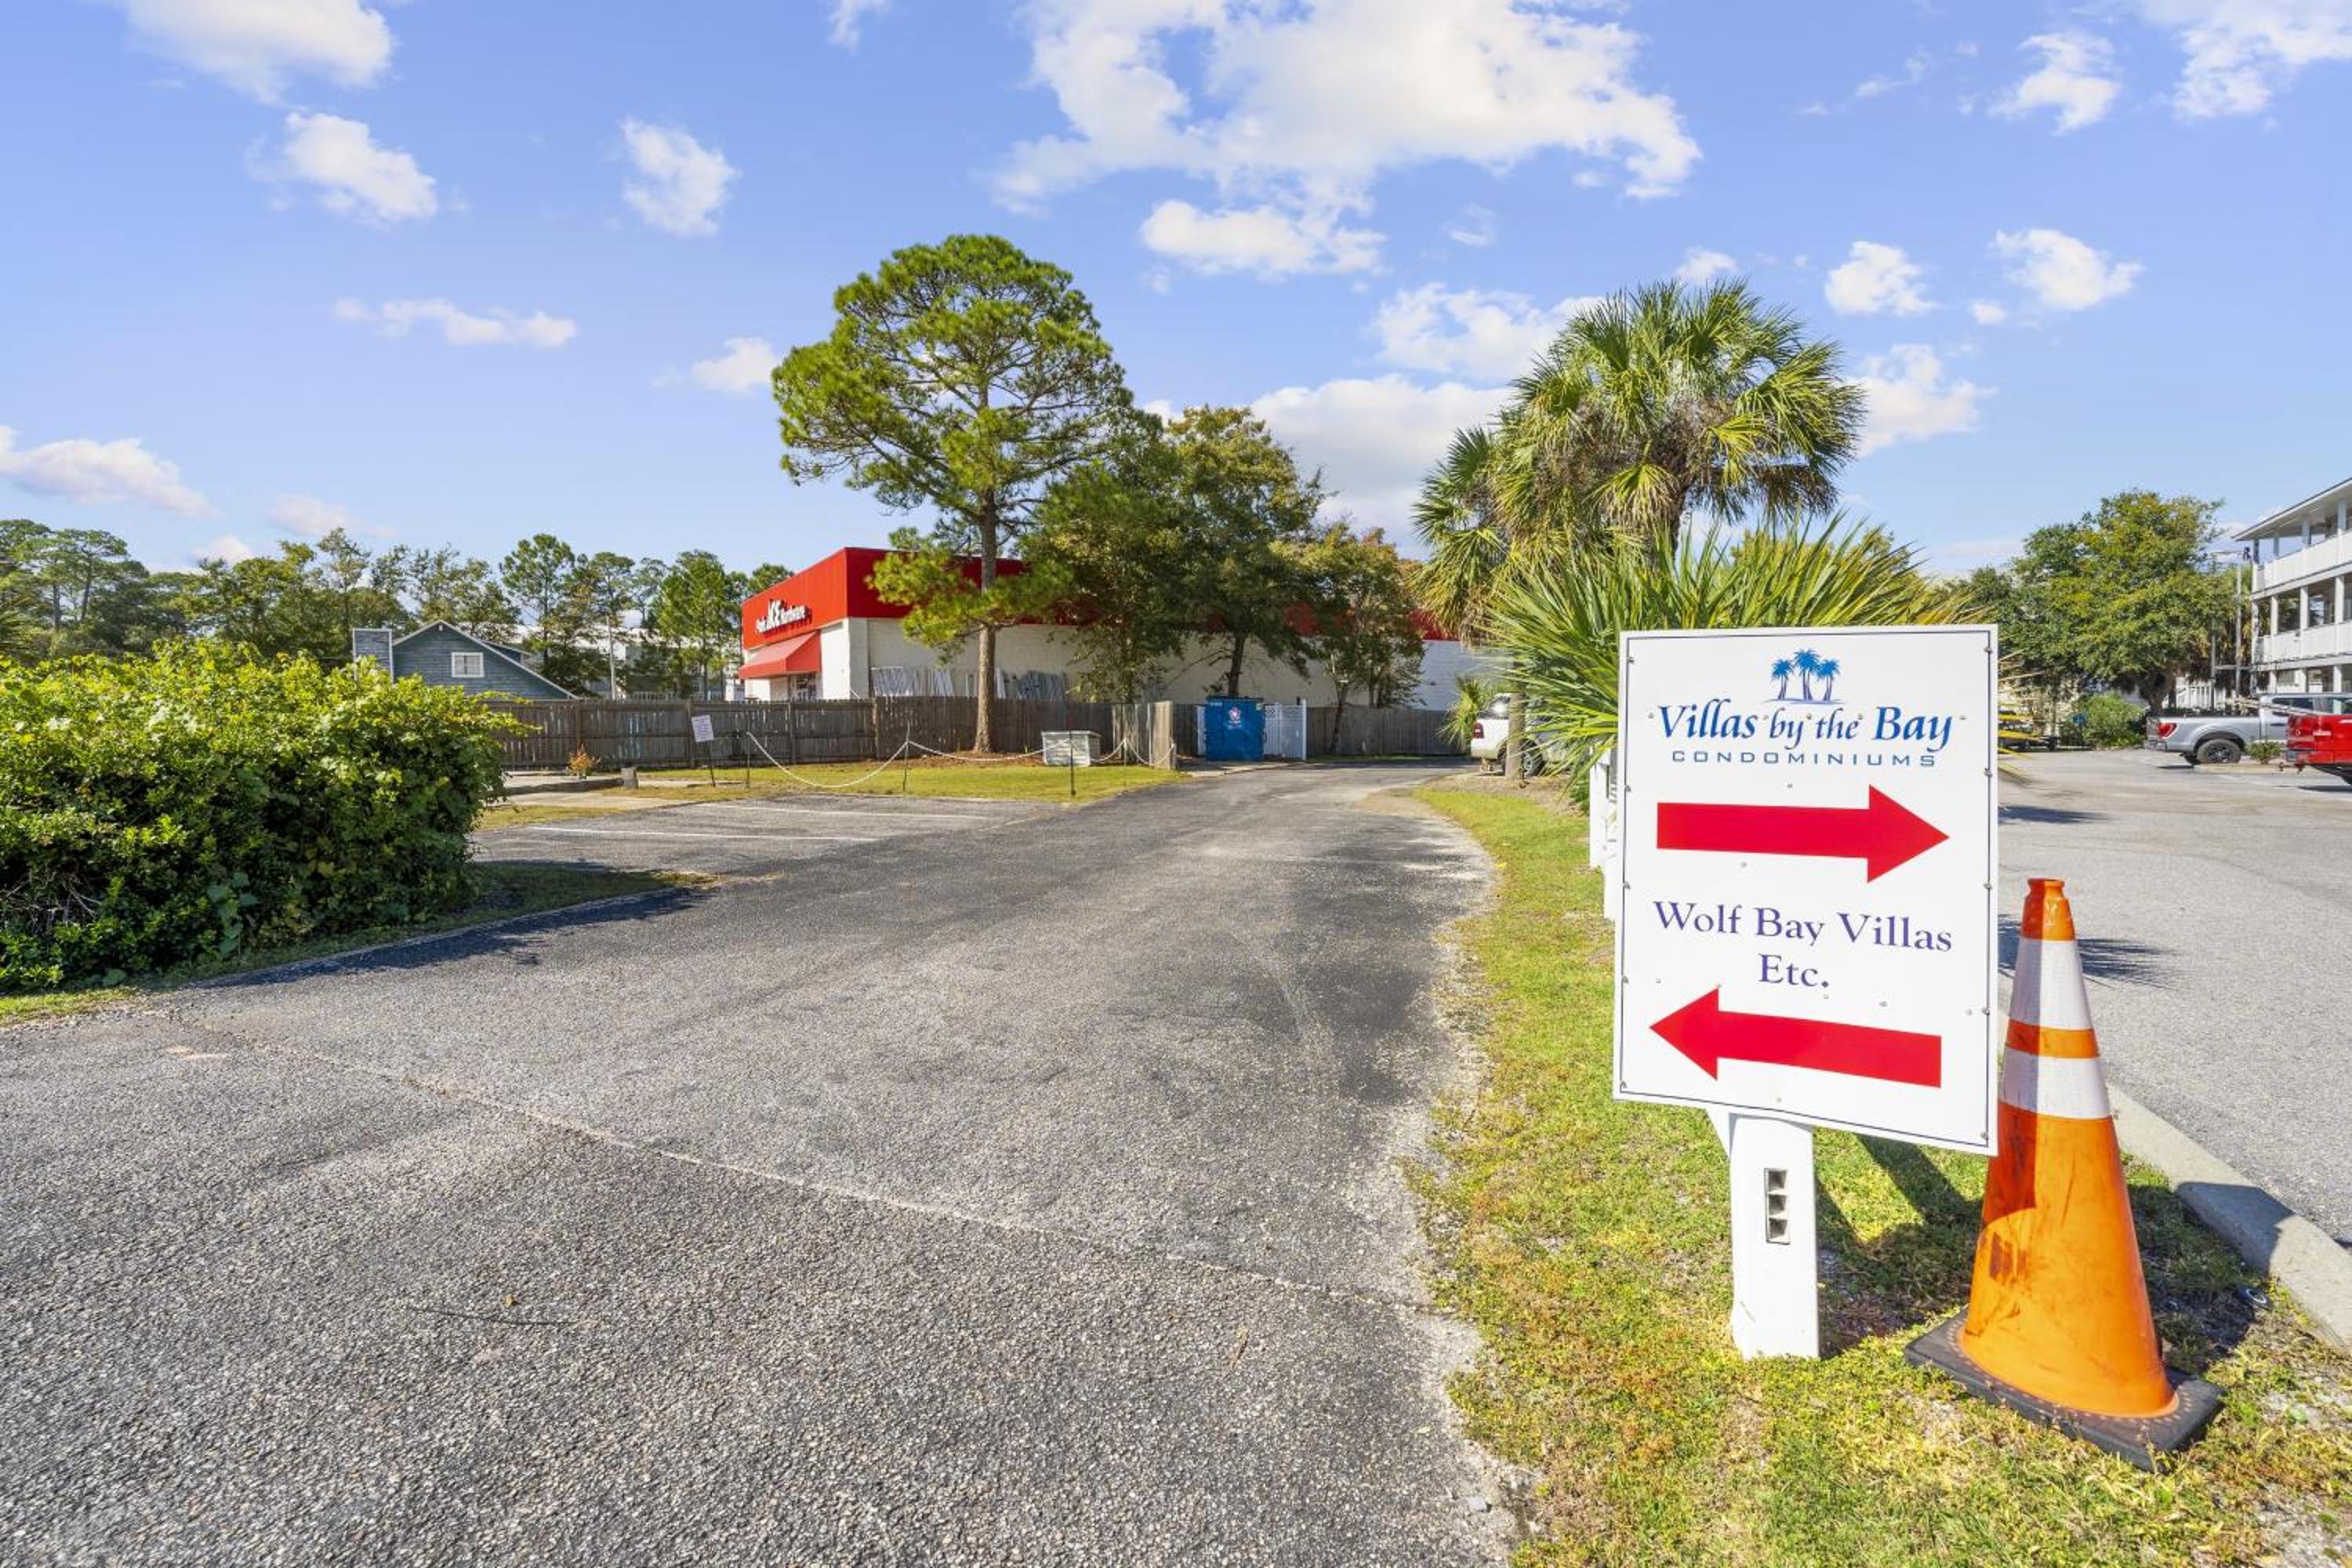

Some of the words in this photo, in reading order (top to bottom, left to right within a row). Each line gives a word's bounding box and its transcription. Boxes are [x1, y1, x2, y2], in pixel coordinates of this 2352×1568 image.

[1658, 699, 1759, 739] Villas
[1769, 708, 1803, 750] by
[1816, 708, 1859, 739] the
[1872, 706, 1953, 753] Bay
[1672, 750, 1936, 767] CONDOMINIUMS
[1653, 901, 1742, 934] Wolf
[1754, 907, 1824, 946] Bay
[1836, 912, 1952, 952] Villas
[1759, 953, 1829, 988] Etc.
